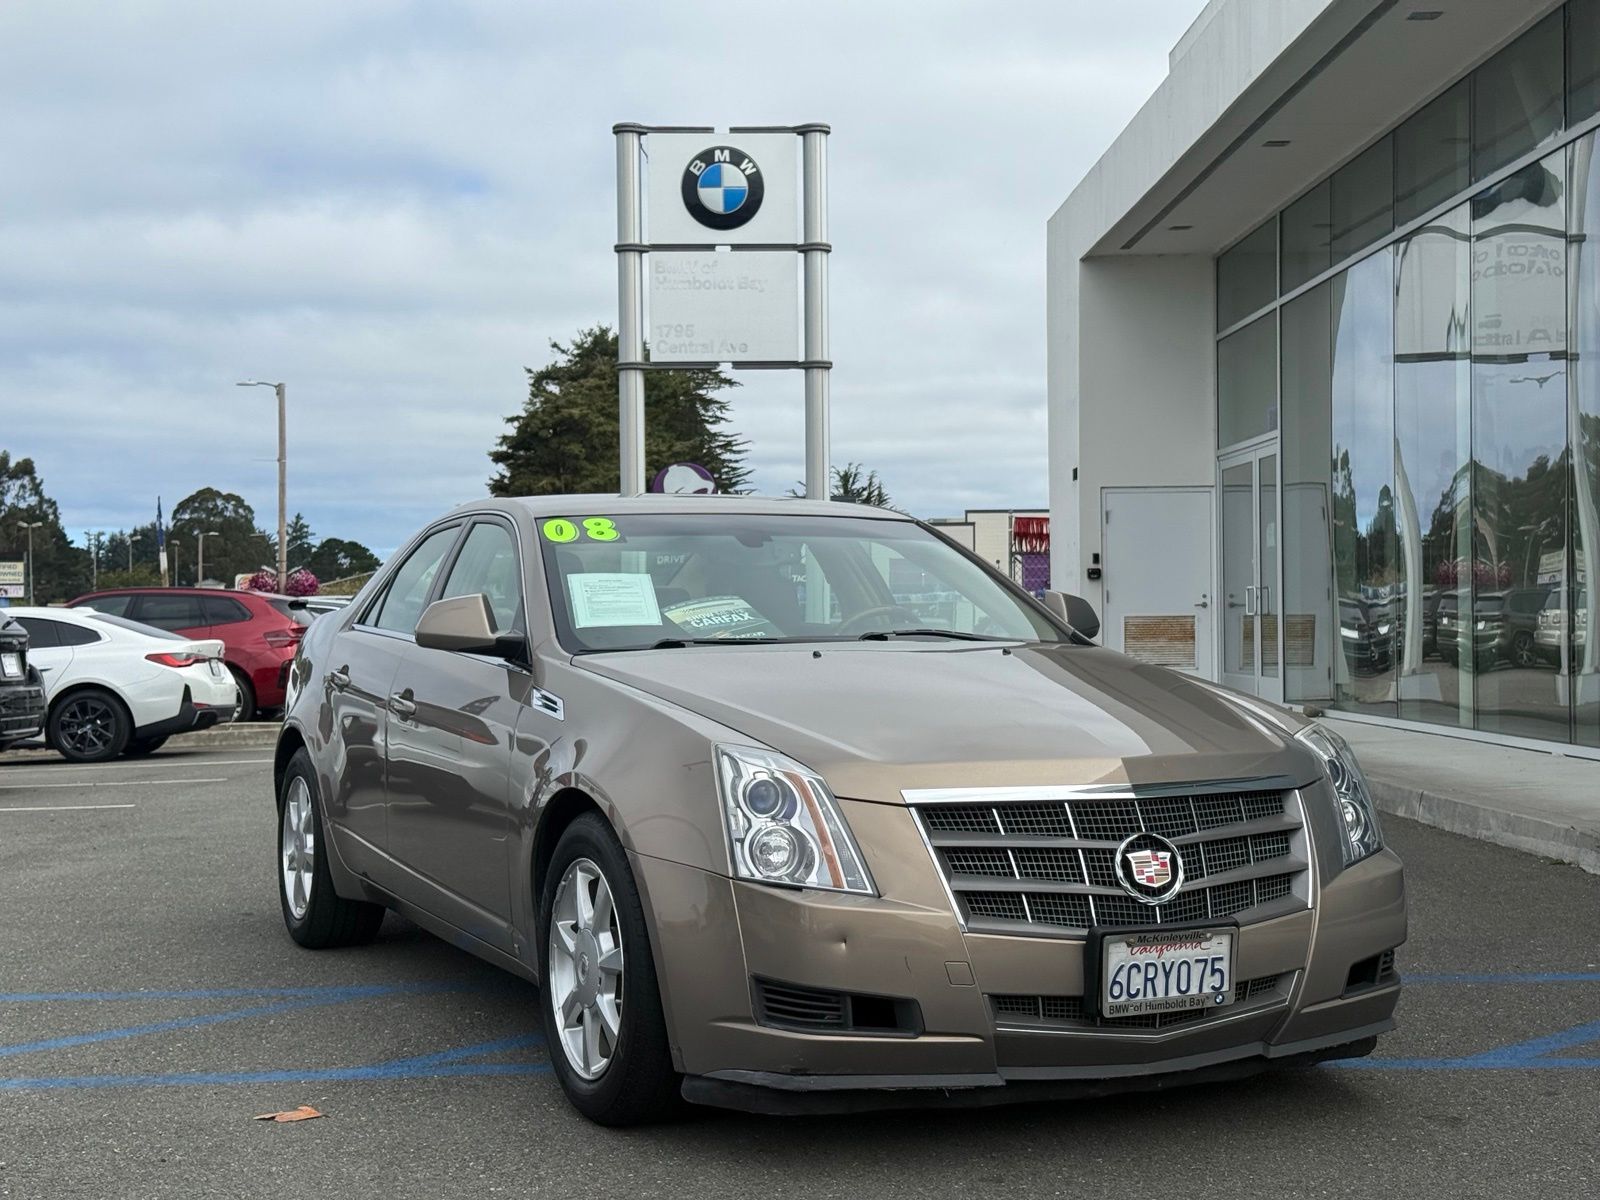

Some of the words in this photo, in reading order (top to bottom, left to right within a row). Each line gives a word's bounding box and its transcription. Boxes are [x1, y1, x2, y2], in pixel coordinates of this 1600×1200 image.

[688, 149, 757, 177] BMW
[655, 323, 695, 338] 1795
[655, 339, 714, 354] Central
[717, 340, 749, 354] Ave
[691, 611, 754, 628] CARFAX
[1136, 931, 1205, 944] McKinleyville
[1109, 956, 1225, 1000] 6CRY075
[1109, 1003, 1129, 1015] BMW
[1133, 1002, 1142, 1012] of
[1145, 999, 1187, 1010] Humboldt
[1189, 997, 1205, 1008] Bay
